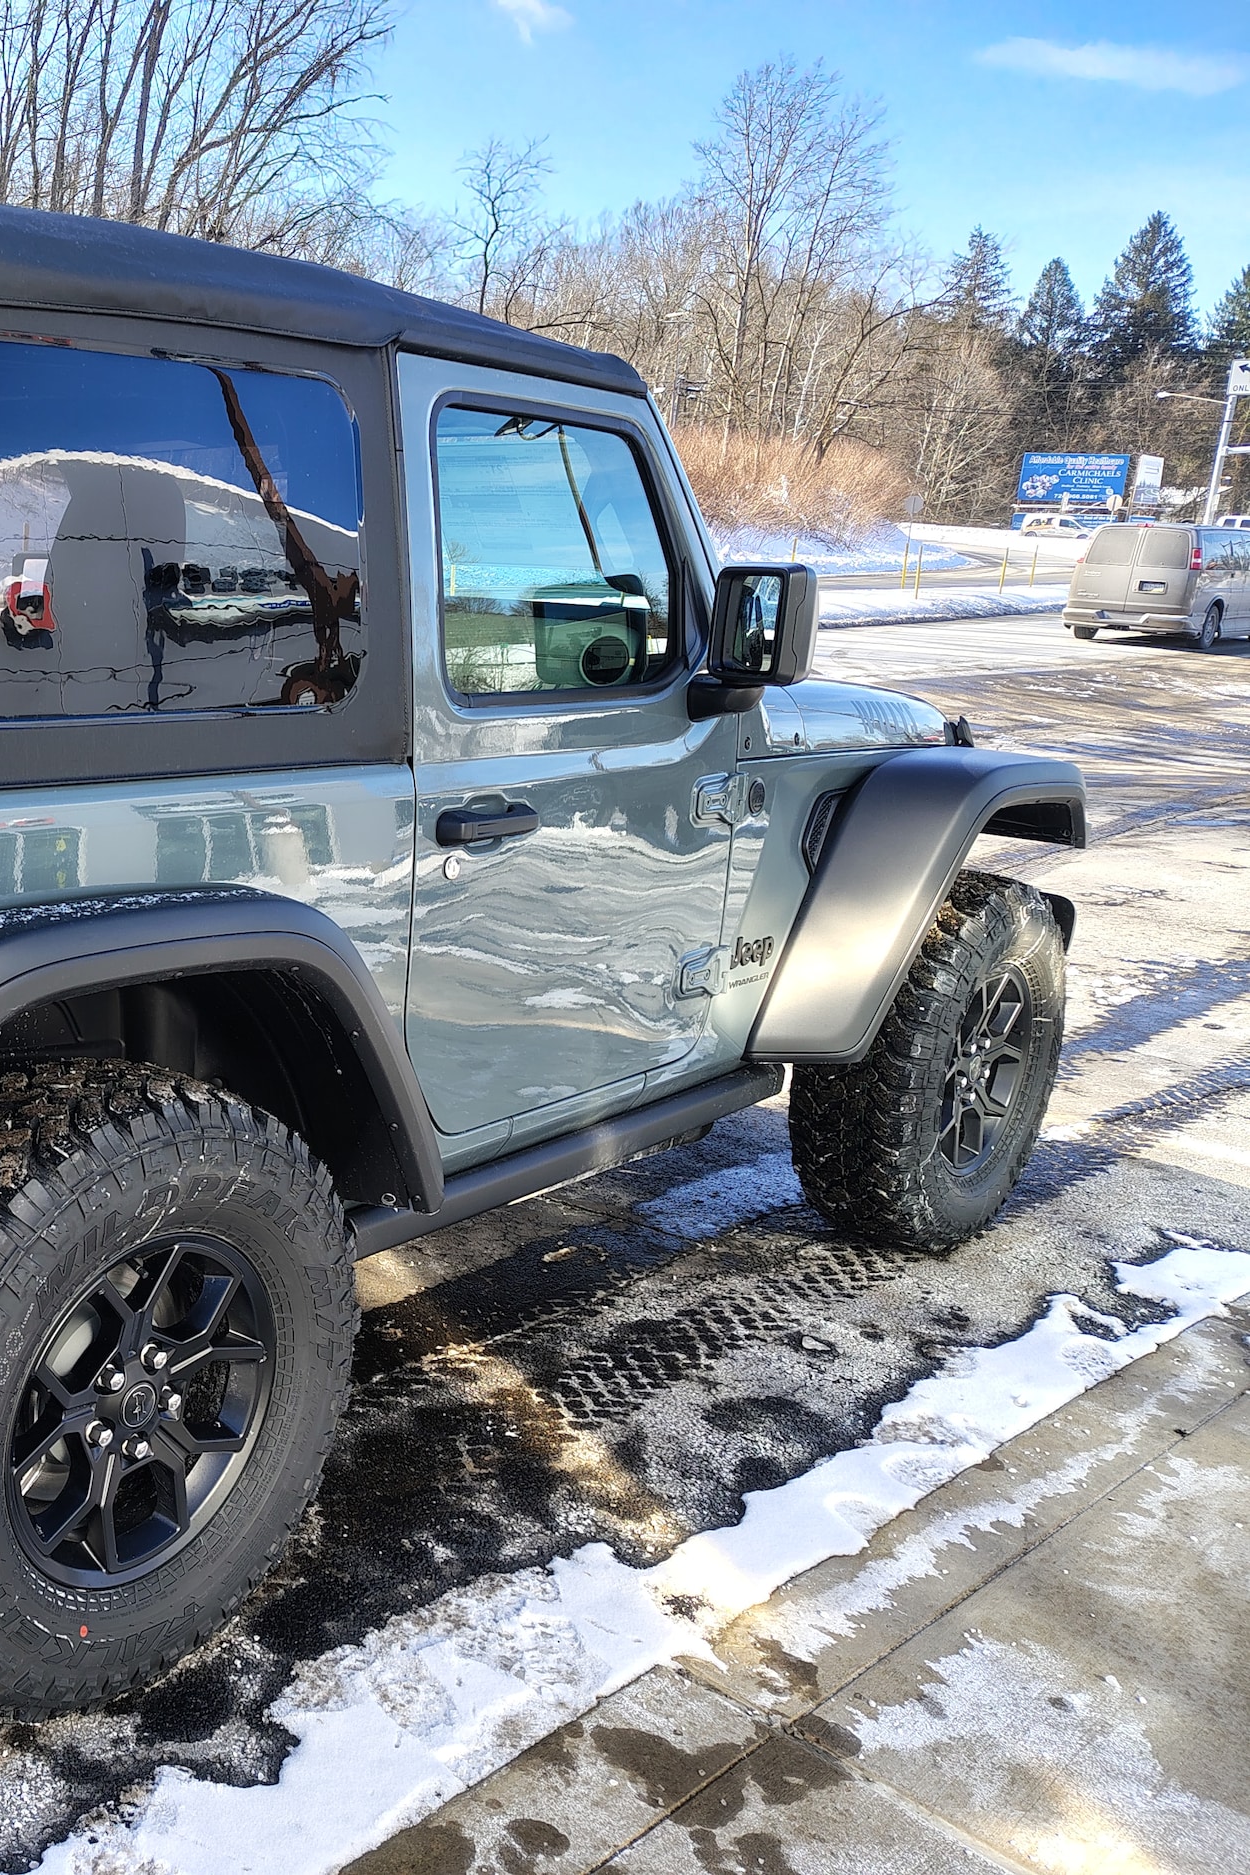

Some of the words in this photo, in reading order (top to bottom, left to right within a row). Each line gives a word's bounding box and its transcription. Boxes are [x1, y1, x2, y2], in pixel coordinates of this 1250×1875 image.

[1232, 384, 1250, 392] ONL
[1029, 455, 1063, 465] Affordable
[1064, 456, 1088, 466] Quality
[1088, 457, 1124, 466] Healthcare
[1058, 469, 1122, 477] CARMICHAELS
[1072, 476, 1104, 485] CLINIC
[730, 936, 774, 970] Jeep
[728, 972, 769, 989] WRANGLER
